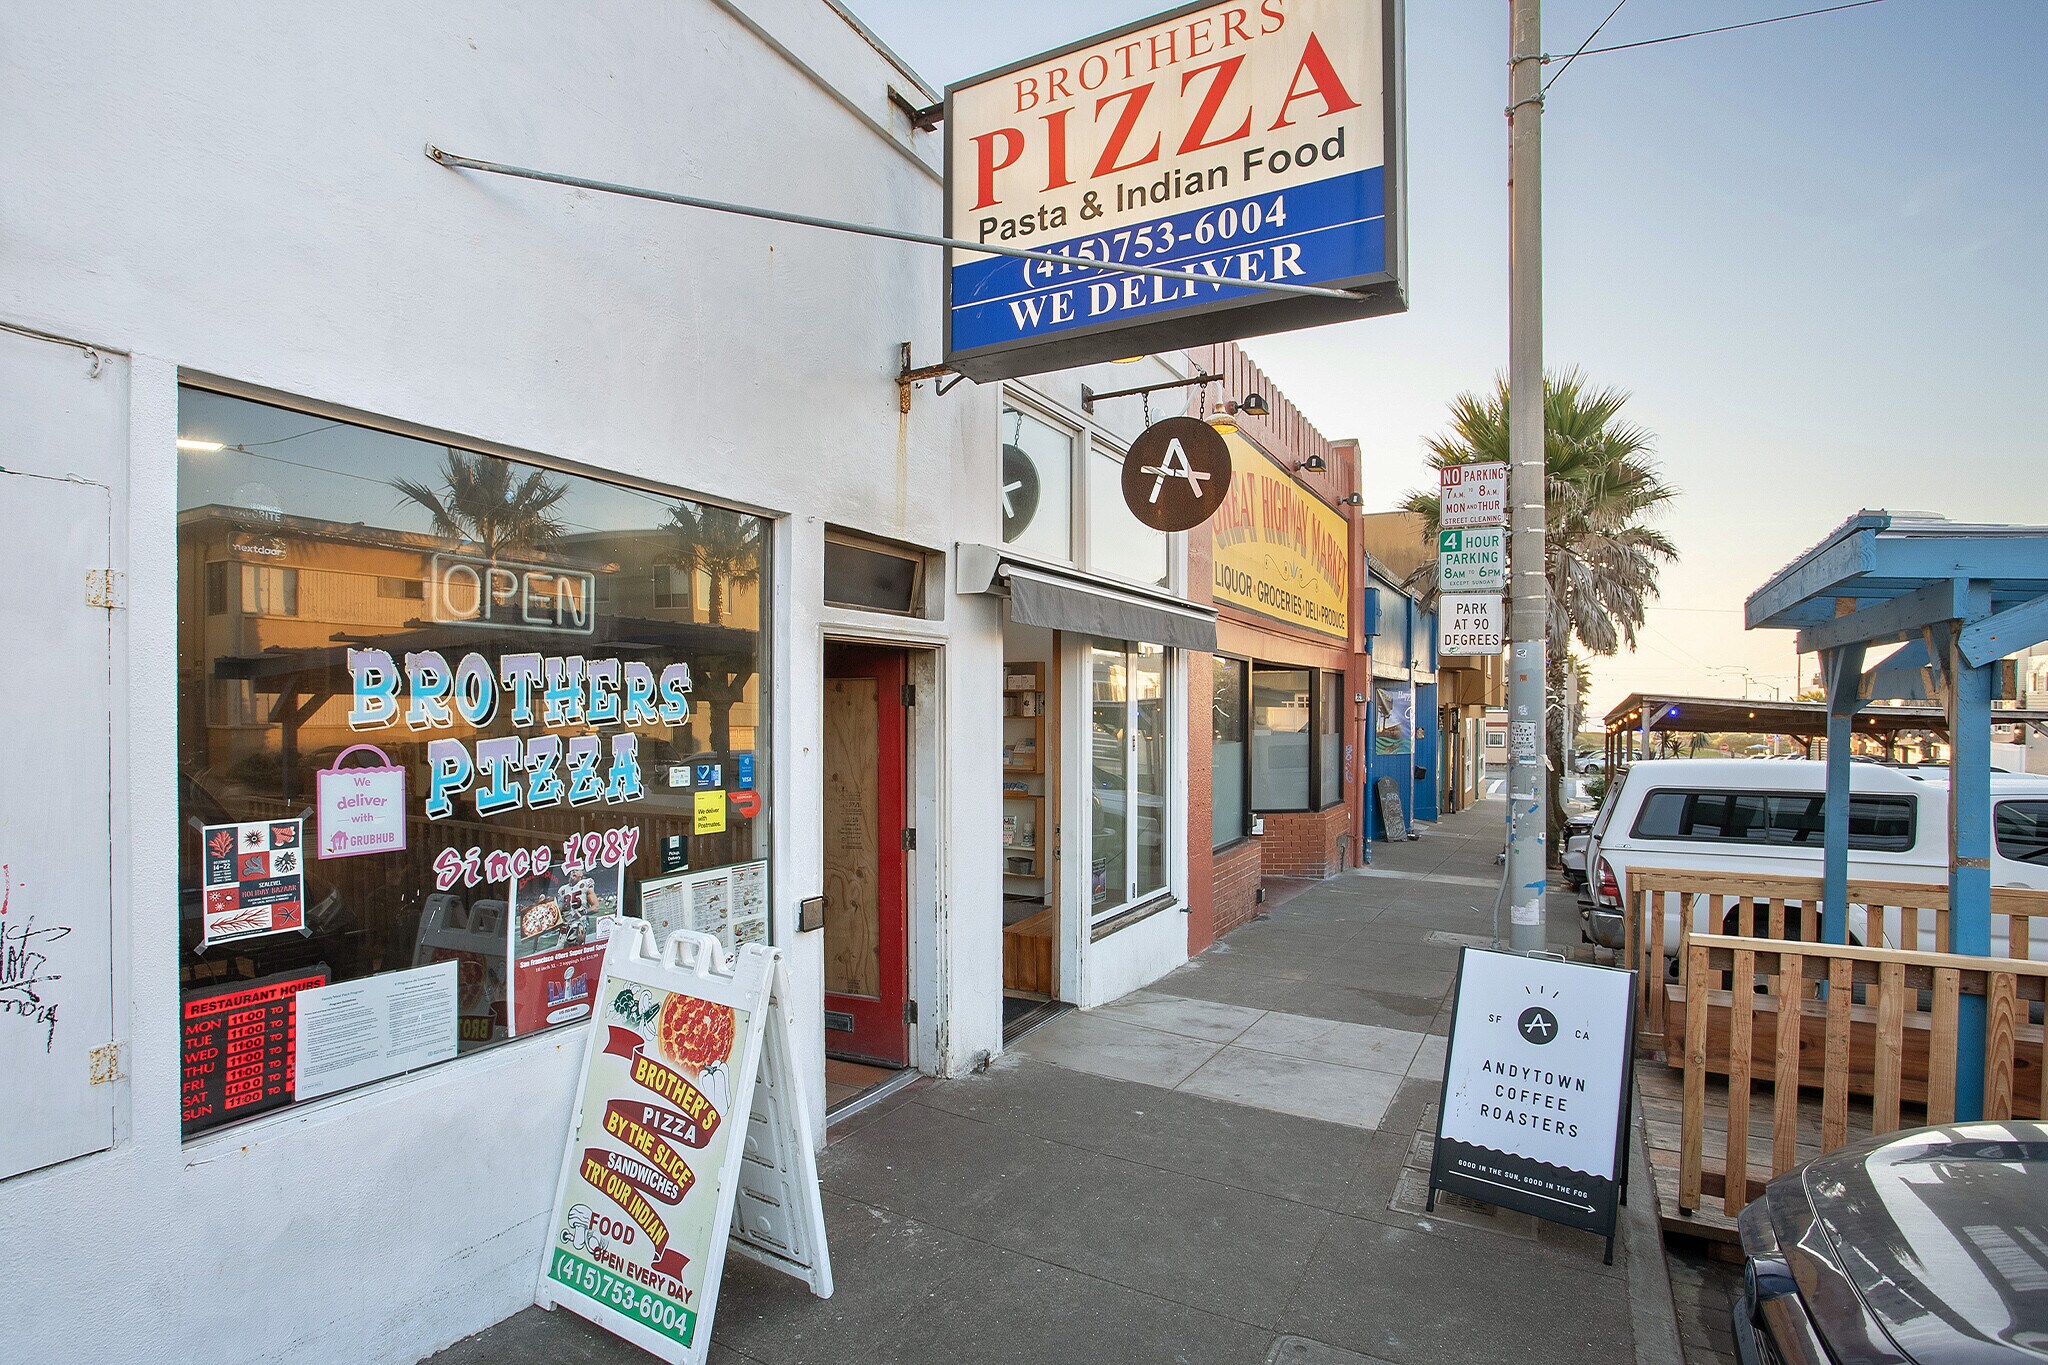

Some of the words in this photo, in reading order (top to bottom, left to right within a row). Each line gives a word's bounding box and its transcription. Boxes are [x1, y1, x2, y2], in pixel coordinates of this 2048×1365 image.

[1014, 0, 1286, 114] BROTHERS
[969, 32, 1362, 212] PIZZA
[979, 203, 1068, 245] Pasta
[1080, 190, 1104, 221] &
[1116, 163, 1229, 213] Indian
[1243, 127, 1346, 181] Food
[1008, 287, 1075, 332] WE
[1087, 242, 1307, 317] DELIVER
[1443, 468, 1460, 485] NO
[1464, 467, 1504, 482] PARKING
[1444, 517, 1468, 525] STREET
[1470, 514, 1502, 523] CLEANING
[1446, 503, 1466, 514] MON
[1477, 500, 1500, 511] THUR
[1311, 512, 1347, 596] MARKET
[1444, 532, 1457, 550] 4
[1465, 535, 1500, 549] HOUR
[1446, 551, 1498, 565] PARKING
[444, 564, 587, 627] OPEN
[1214, 561, 1252, 598] LIQUOR
[1257, 580, 1303, 616] GROCERIES
[1305, 600, 1319, 622] DELI
[1321, 605, 1345, 630] PRODUCE
[1456, 602, 1488, 615] PARK
[1444, 634, 1499, 646] DEGREES
[1453, 618, 1468, 630] AT
[1473, 618, 1489, 630] 90
[347, 648, 693, 732] BROTHERS
[353, 777, 371, 787] We
[426, 733, 645, 821] PIZZA
[337, 793, 388, 810] deliver
[351, 813, 374, 823] with
[350, 832, 395, 847] GRUBHUB
[433, 845, 552, 892] Since
[561, 825, 640, 875] 1987
[190, 988, 277, 1016] RESTAURANT
[280, 979, 322, 996] HOURS
[185, 1018, 222, 1036] MON
[271, 1005, 284, 1014] TO
[185, 1034, 212, 1050] TUE
[270, 1019, 283, 1028] TO
[1488, 1013, 1502, 1024] SF
[1575, 1029, 1590, 1041] CA
[184, 1047, 218, 1064] WED
[270, 1033, 283, 1041] TO
[184, 1062, 215, 1079] THU
[269, 1046, 282, 1055] TO
[182, 1091, 208, 1107] SAT
[268, 1073, 281, 1082] TO
[183, 1078, 205, 1094] FRI
[268, 1059, 282, 1068] TO
[1482, 1059, 1585, 1092] ANDYTOWN
[182, 1105, 213, 1122] SUN
[267, 1086, 281, 1095] TO
[635, 1057, 717, 1131] BROTHER'S
[1495, 1084, 1568, 1112] COFFEE
[642, 1106, 697, 1144] PIZZA
[1480, 1103, 1578, 1138] ROASTERS
[606, 1110, 629, 1138] BY
[626, 1122, 656, 1156] THE
[653, 1144, 692, 1189] SLICE
[607, 1152, 679, 1200] SANDWICHES
[1458, 1159, 1476, 1169] GOOD
[1478, 1164, 1486, 1172] IN
[1489, 1167, 1502, 1176] THE
[1504, 1171, 1521, 1182] SUN,
[1523, 1176, 1543, 1187] GOOD
[1545, 1182, 1554, 1190] IN
[1556, 1184, 1571, 1194] THE
[1573, 1189, 1588, 1199] FOG
[584, 1158, 609, 1187] TRY
[606, 1175, 632, 1206] OUR
[627, 1194, 667, 1246] INDIAN
[588, 1211, 635, 1246] FOOD
[593, 1246, 625, 1274] OPEN
[626, 1261, 666, 1292] EVERY
[667, 1279, 693, 1305] DAY
[556, 1254, 688, 1337] (415)753-6004
